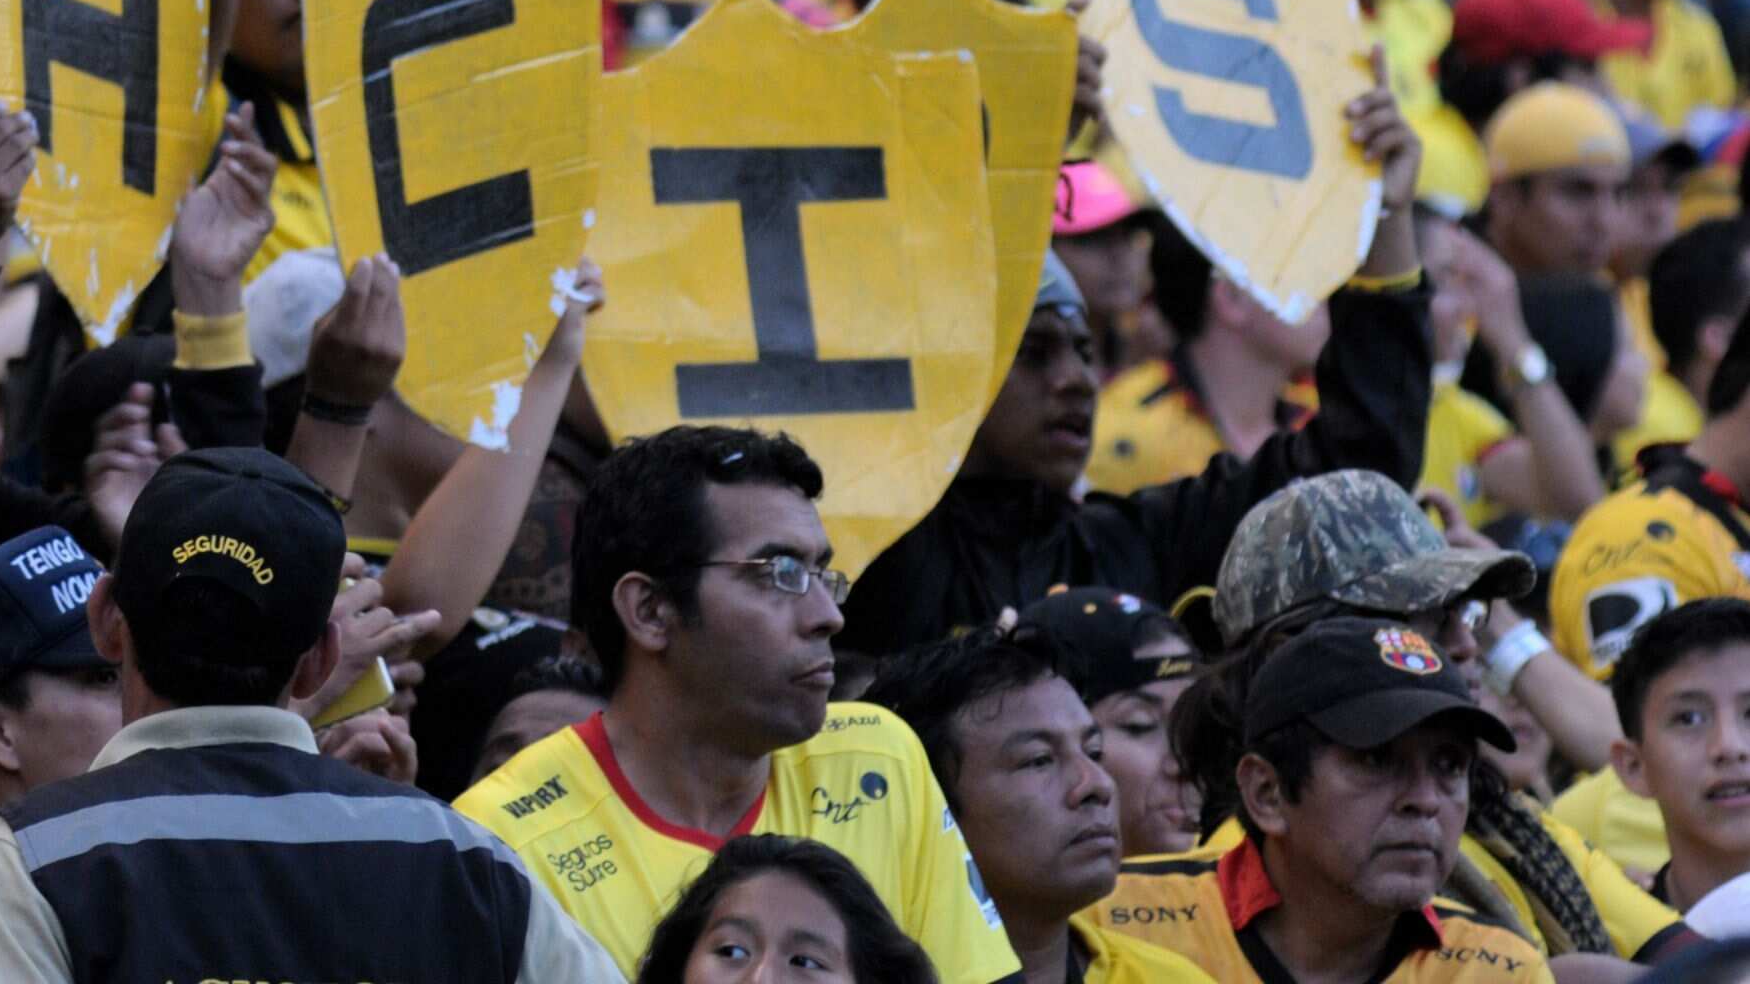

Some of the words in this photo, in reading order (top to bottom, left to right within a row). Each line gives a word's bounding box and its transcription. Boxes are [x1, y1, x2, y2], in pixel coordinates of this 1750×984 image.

[649, 146, 916, 418] I
[10, 535, 85, 580] TENGO
[172, 535, 274, 585] SEGURIDAD
[1110, 903, 1199, 925] SONY
